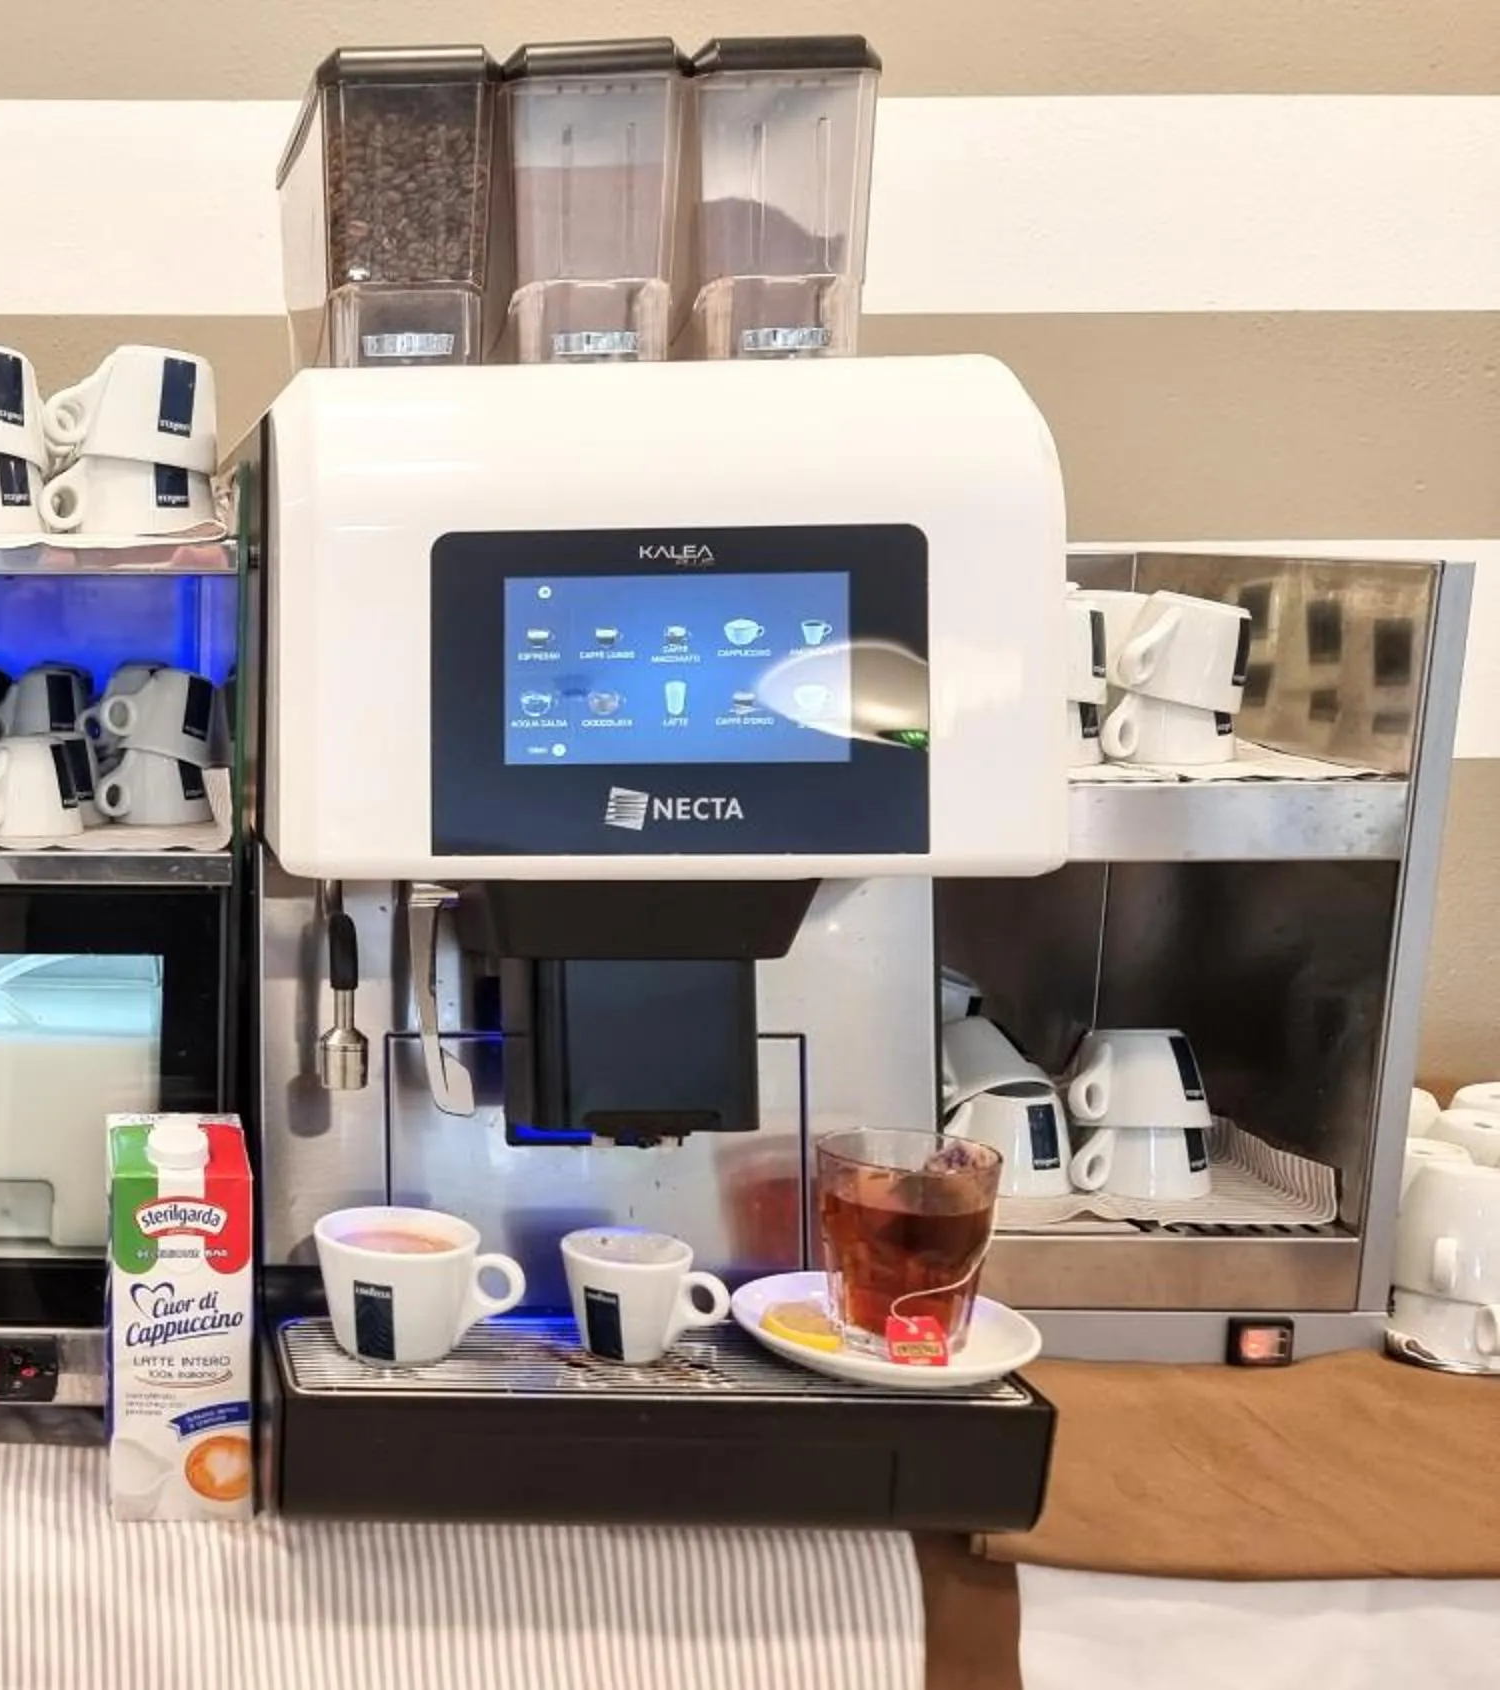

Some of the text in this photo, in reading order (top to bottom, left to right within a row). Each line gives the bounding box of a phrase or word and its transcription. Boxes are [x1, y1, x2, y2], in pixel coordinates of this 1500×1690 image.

[639, 545, 714, 559] KALEA
[653, 797, 744, 820] NECTA
[141, 1204, 221, 1228] sterilgarda
[153, 1290, 219, 1319] Cuor di
[126, 1309, 244, 1347] Cappuccino
[133, 1356, 231, 1367] LATTE INTERO
